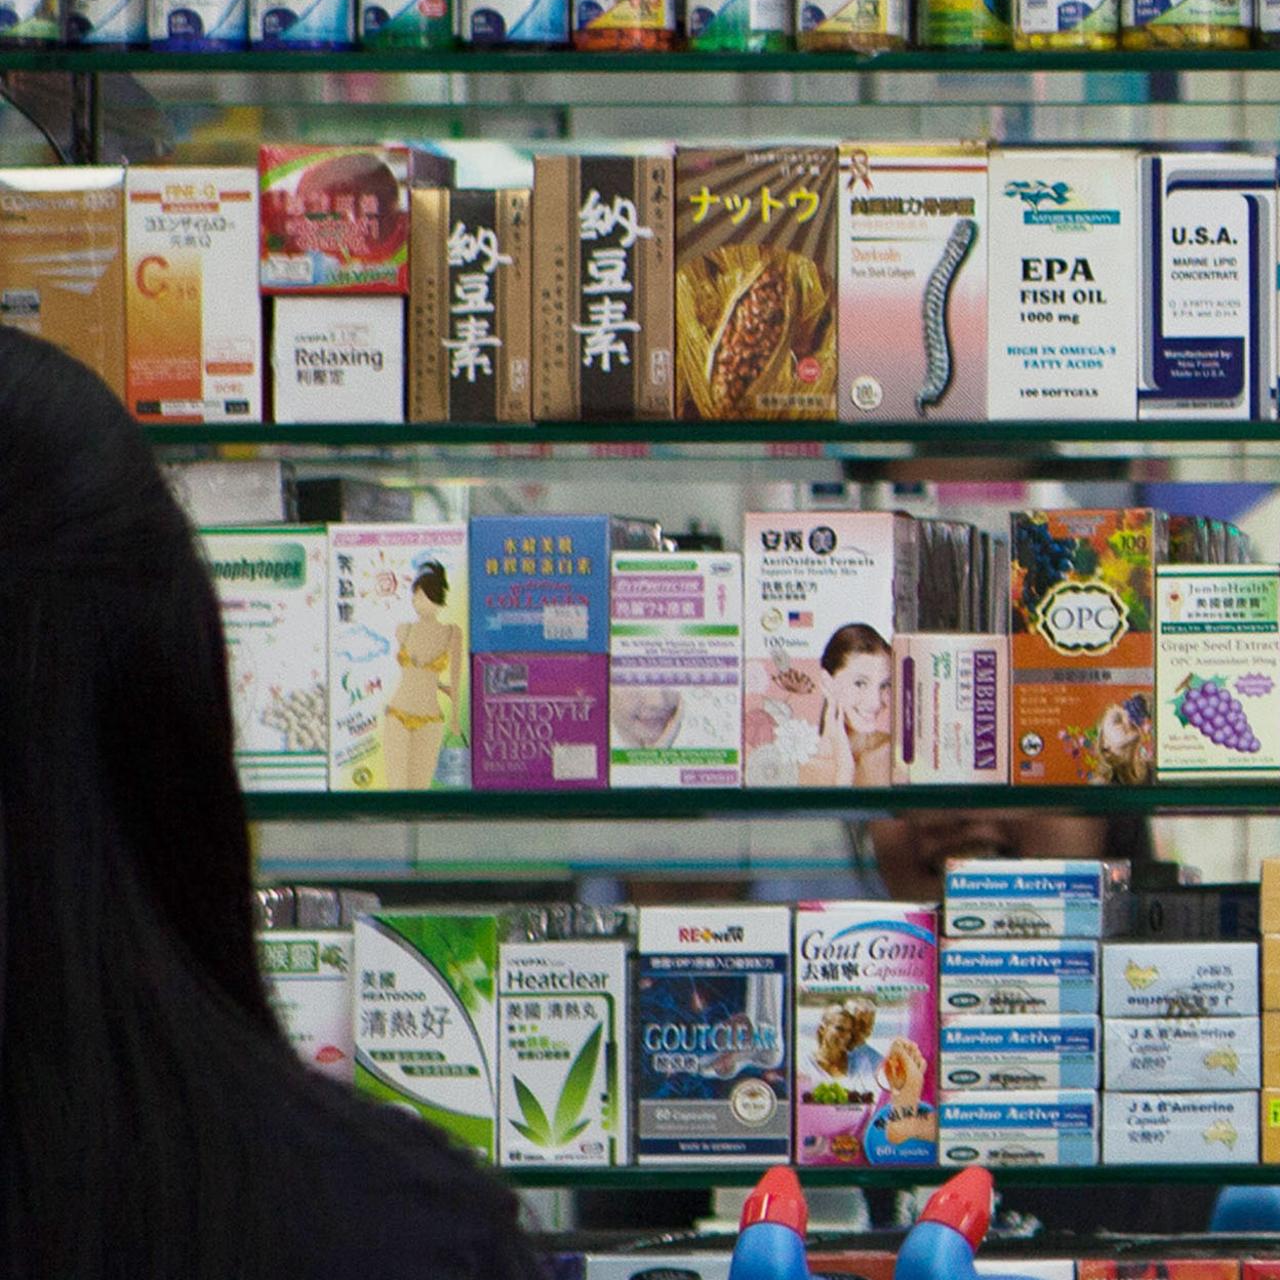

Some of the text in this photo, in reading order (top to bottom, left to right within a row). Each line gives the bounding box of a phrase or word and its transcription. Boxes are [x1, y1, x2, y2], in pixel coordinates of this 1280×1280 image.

[690, 186, 821, 223] ナットウ
[1172, 227, 1239, 246] U.S.A.
[1020, 258, 1094, 283] EPA
[1020, 289, 1107, 305] FISH OIL
[295, 349, 383, 371] Relaxing
[1051, 606, 1116, 634] OPC
[800, 931, 858, 961] Gout
[507, 967, 610, 990] Heatclear
